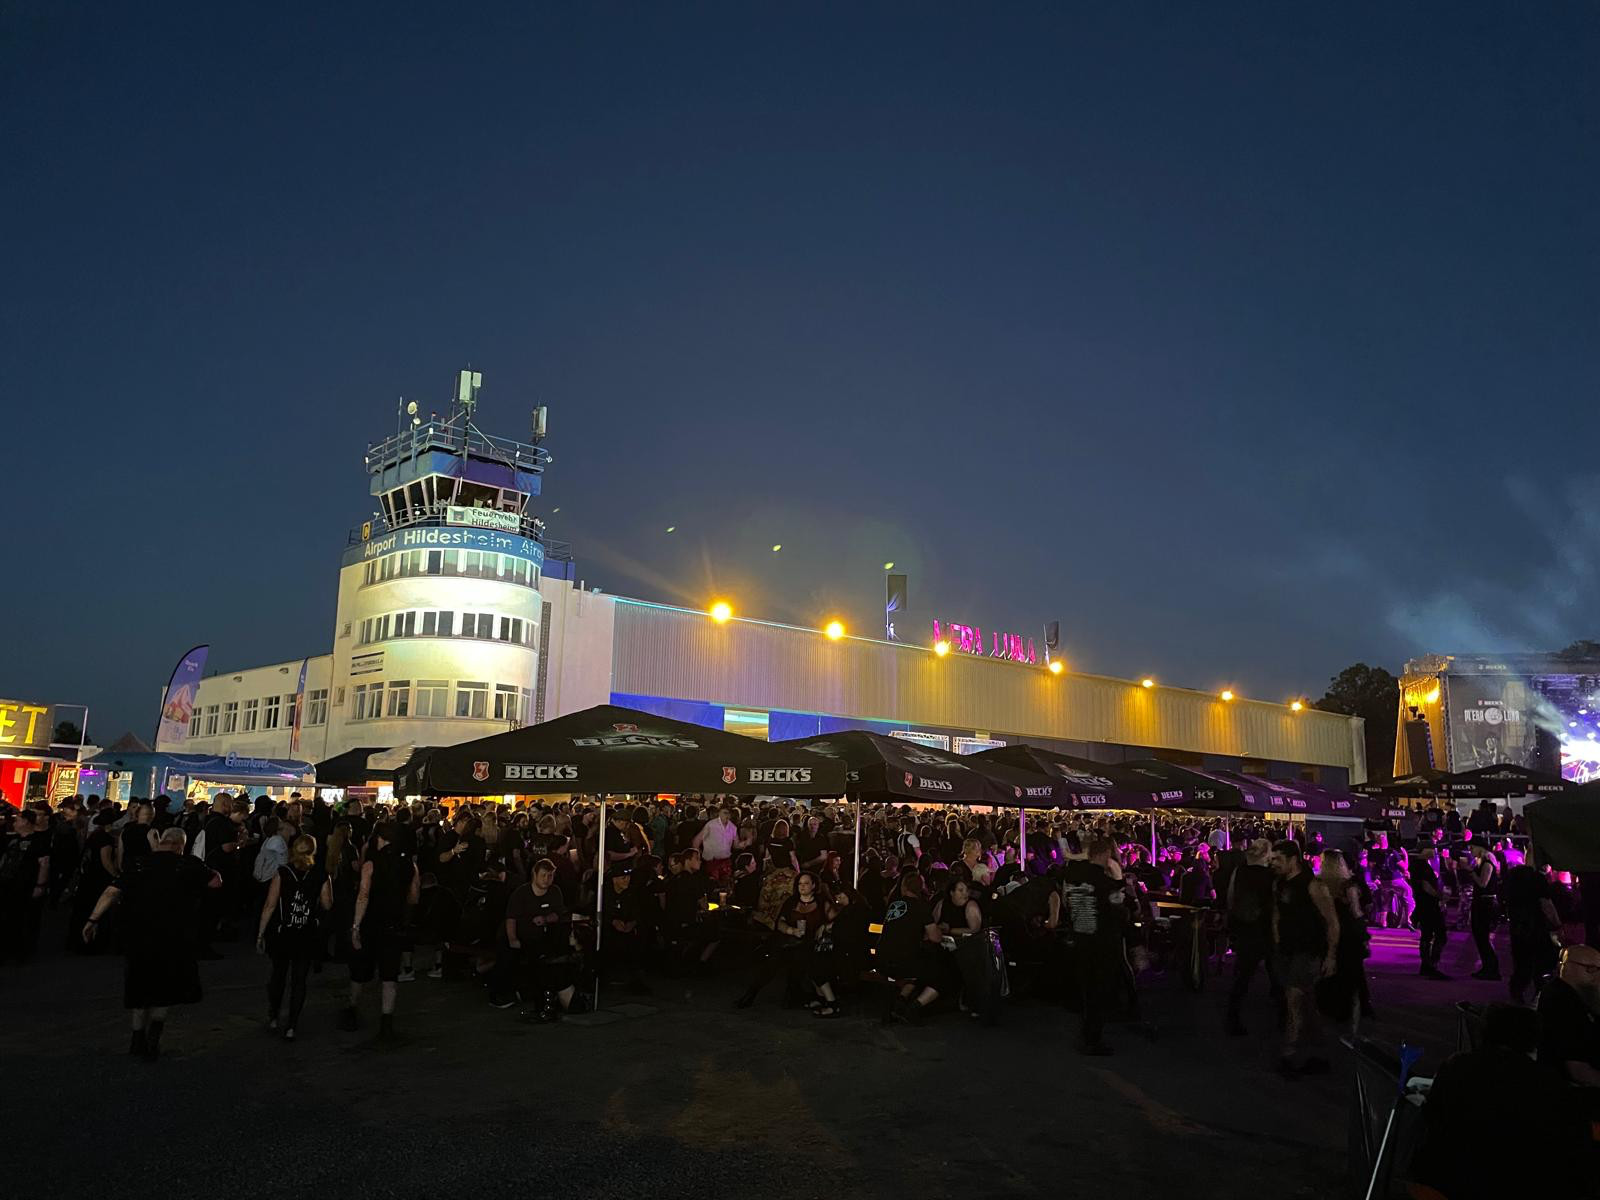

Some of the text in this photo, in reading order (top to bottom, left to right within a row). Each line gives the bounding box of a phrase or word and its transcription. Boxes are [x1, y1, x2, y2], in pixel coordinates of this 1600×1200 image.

[472, 508, 517, 524] Feuerwehr
[471, 518, 518, 532] Hildesheim
[364, 534, 397, 557] Airport
[404, 528, 513, 550] Hildesheim
[504, 764, 579, 779] BECK'S
[749, 767, 813, 782] BECK'S
[919, 777, 953, 790] BECK'S
[1080, 794, 1107, 804] BECK'S
